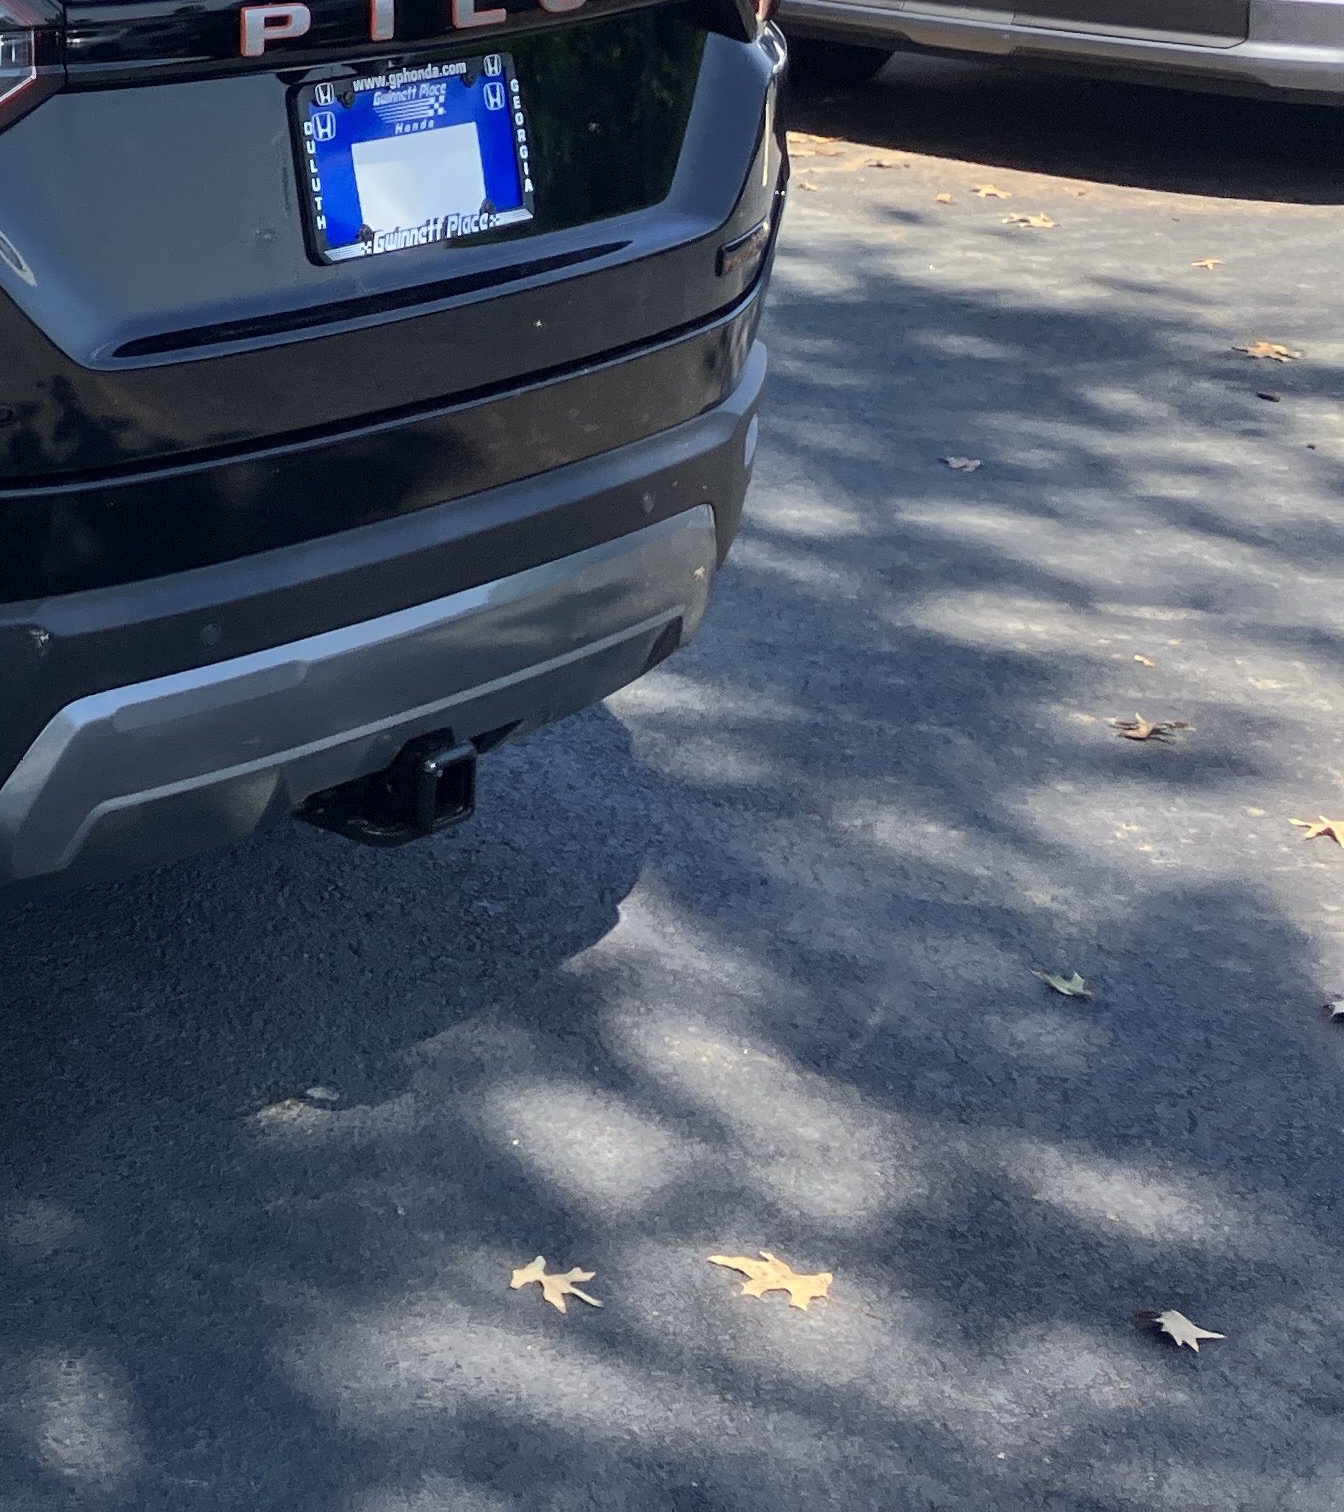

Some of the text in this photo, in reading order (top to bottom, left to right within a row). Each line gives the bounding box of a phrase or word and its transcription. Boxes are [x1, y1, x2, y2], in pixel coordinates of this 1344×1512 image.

[352, 61, 467, 92] www.gphonda.com
[373, 82, 447, 107] Gwinnett Place
[394, 118, 434, 135] Honda
[510, 78, 534, 193] GEORGIA
[303, 121, 327, 230] DULUTH
[372, 212, 489, 254] Gwinnett Place
